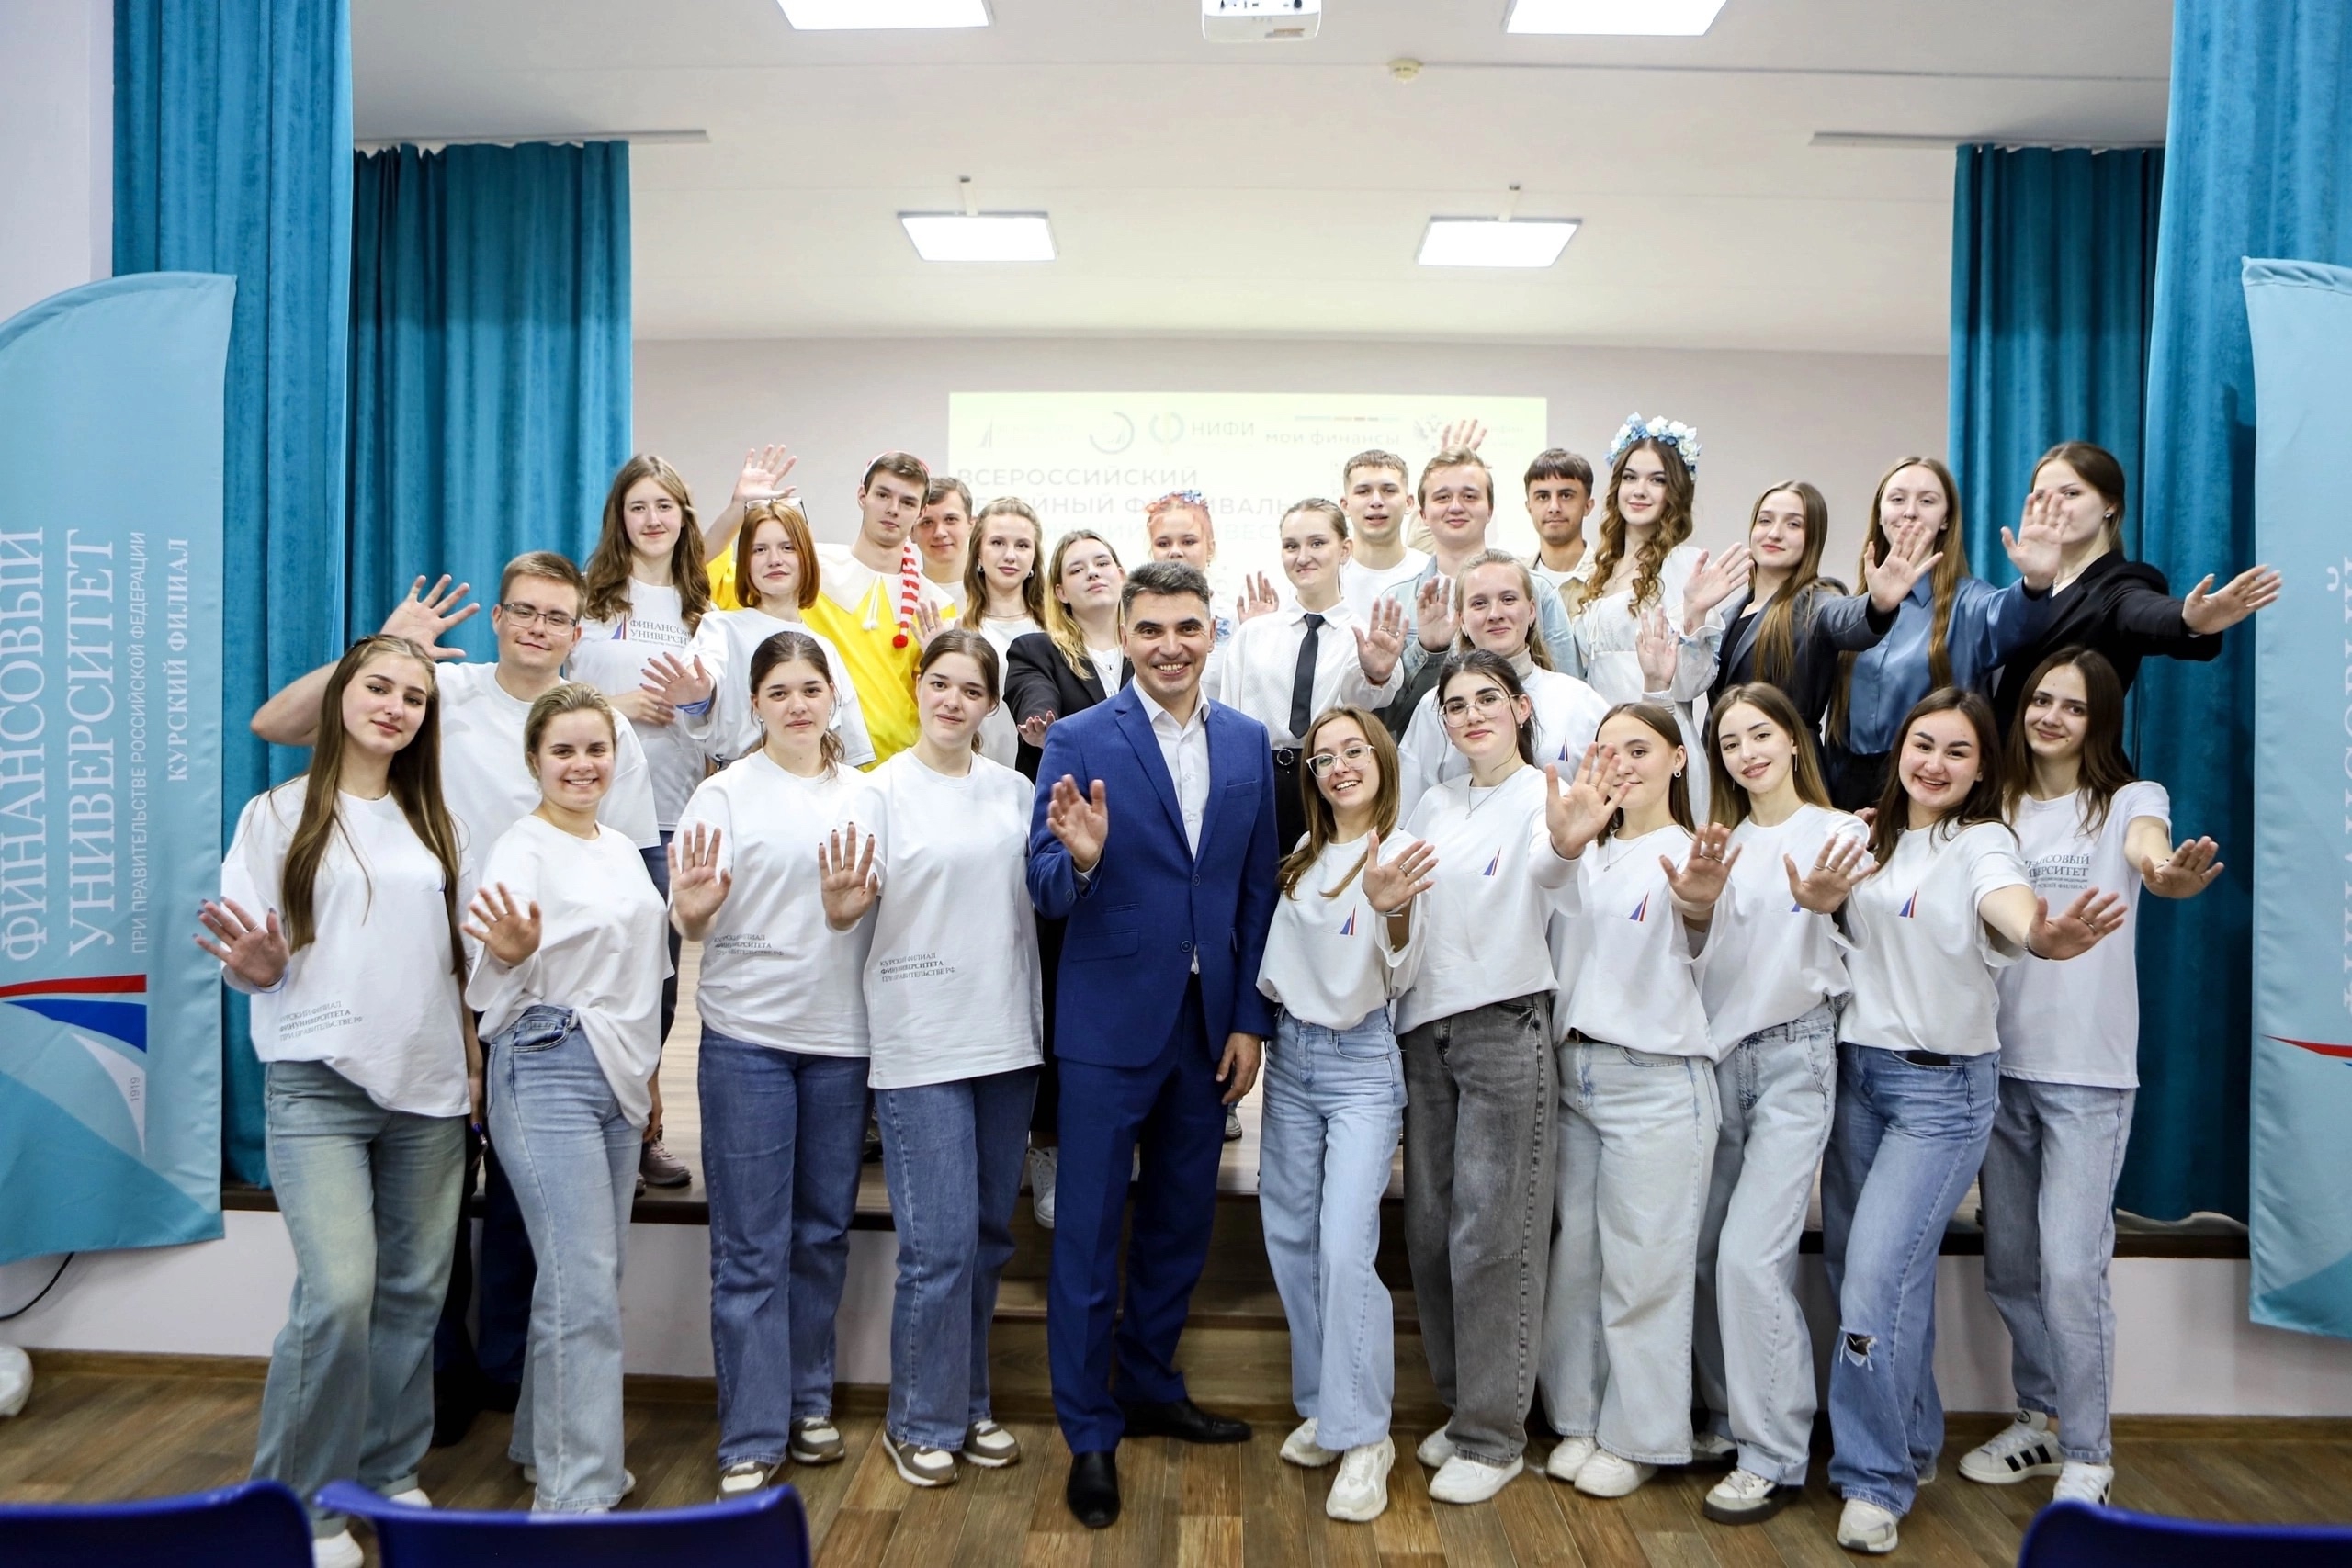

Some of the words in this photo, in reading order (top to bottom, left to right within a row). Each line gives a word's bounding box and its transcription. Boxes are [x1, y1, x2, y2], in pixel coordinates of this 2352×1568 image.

[1191, 420, 1255, 437] НИФИ
[1310, 428, 1400, 447] финансы
[957, 464, 1198, 485] ВСЕРОССИЙСКИЙ
[974, 492, 1114, 514] ЕЙНЫЙ
[1124, 496, 1289, 515] ФВАЛЬ
[127, 531, 148, 639] ФЕДЕРАЦИИ
[167, 538, 190, 653] ФИЛИАЛ
[630, 629, 687, 645] УНИВЕРСИ
[127, 643, 147, 764] РОССИЙСКОЙ
[162, 658, 189, 782] КУРСКИЙ
[65, 528, 117, 958] УНИВЕРСИТЕТ
[130, 767, 148, 911] ПРАВИТЕЛЬСТВЕ
[131, 916, 148, 953] ПРИ
[129, 1076, 141, 1103] 1919
